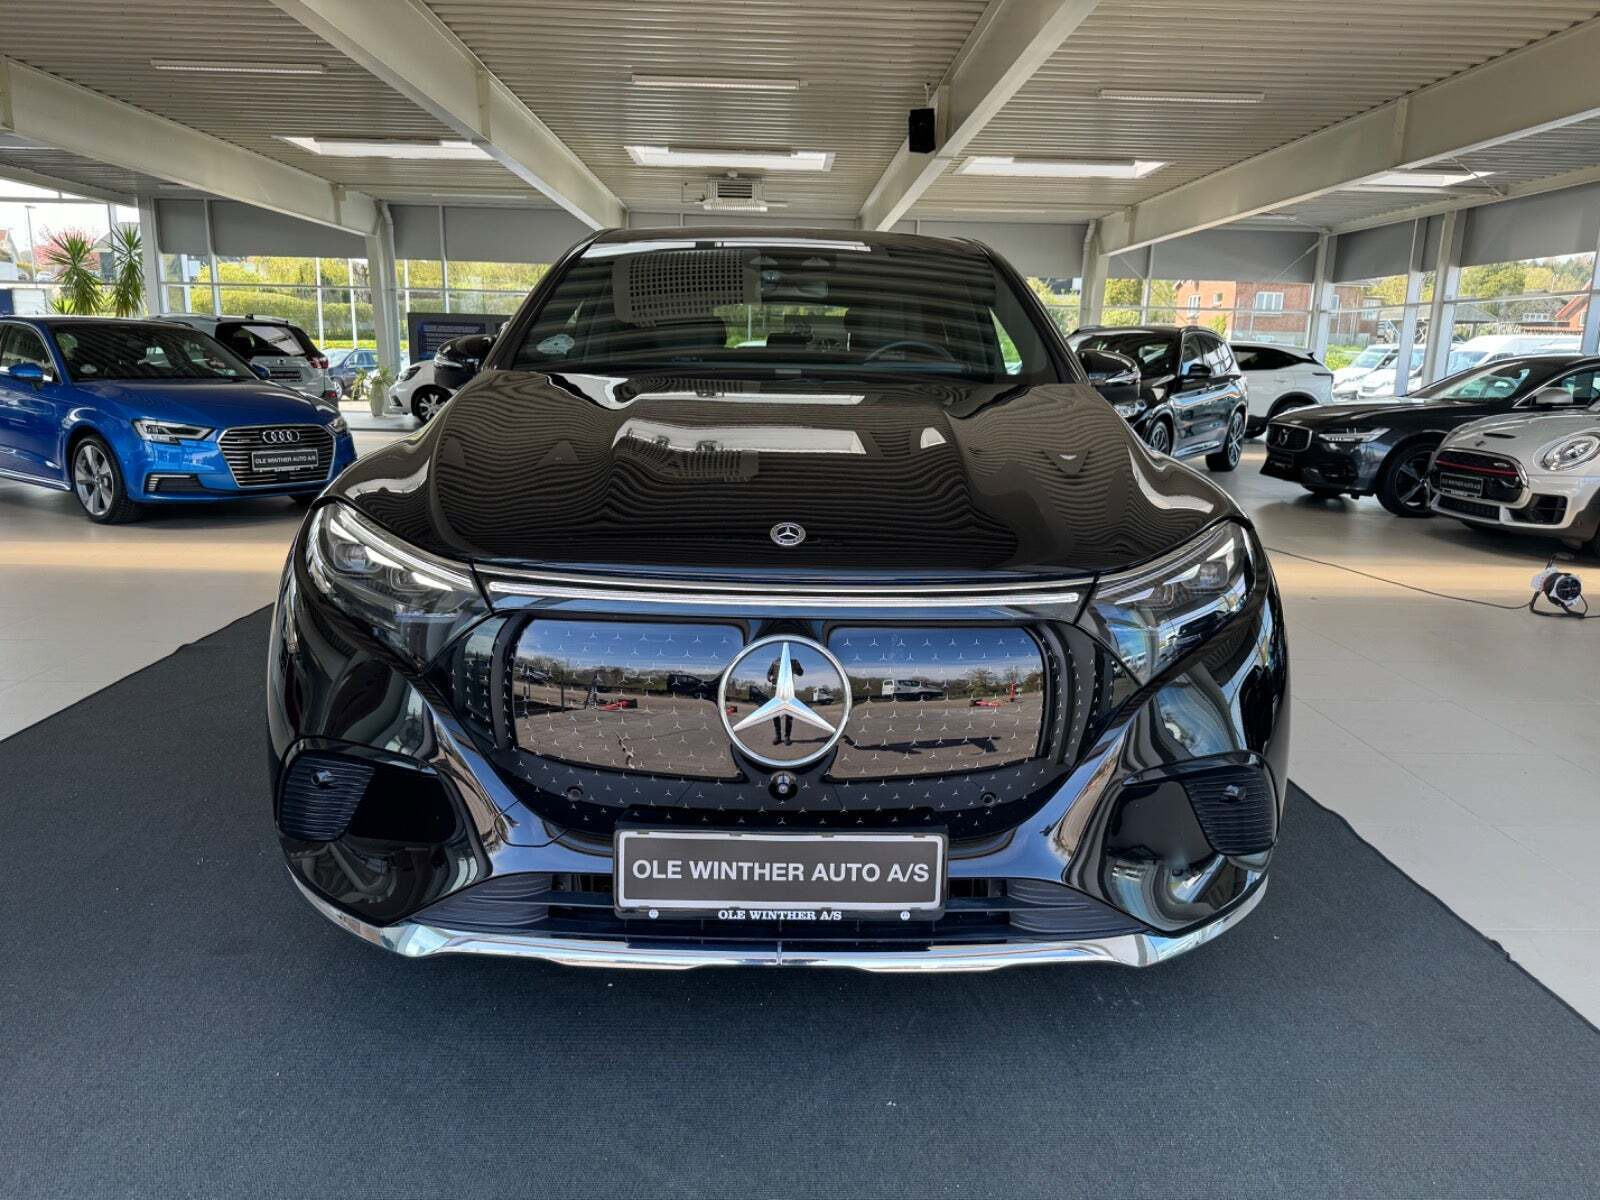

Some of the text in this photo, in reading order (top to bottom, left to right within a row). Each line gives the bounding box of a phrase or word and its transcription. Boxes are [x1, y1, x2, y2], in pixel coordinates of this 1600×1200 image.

[632, 859, 929, 883] OLE WINTHER AUTO A/S
[718, 910, 842, 921] OLE WINTHER A/S
